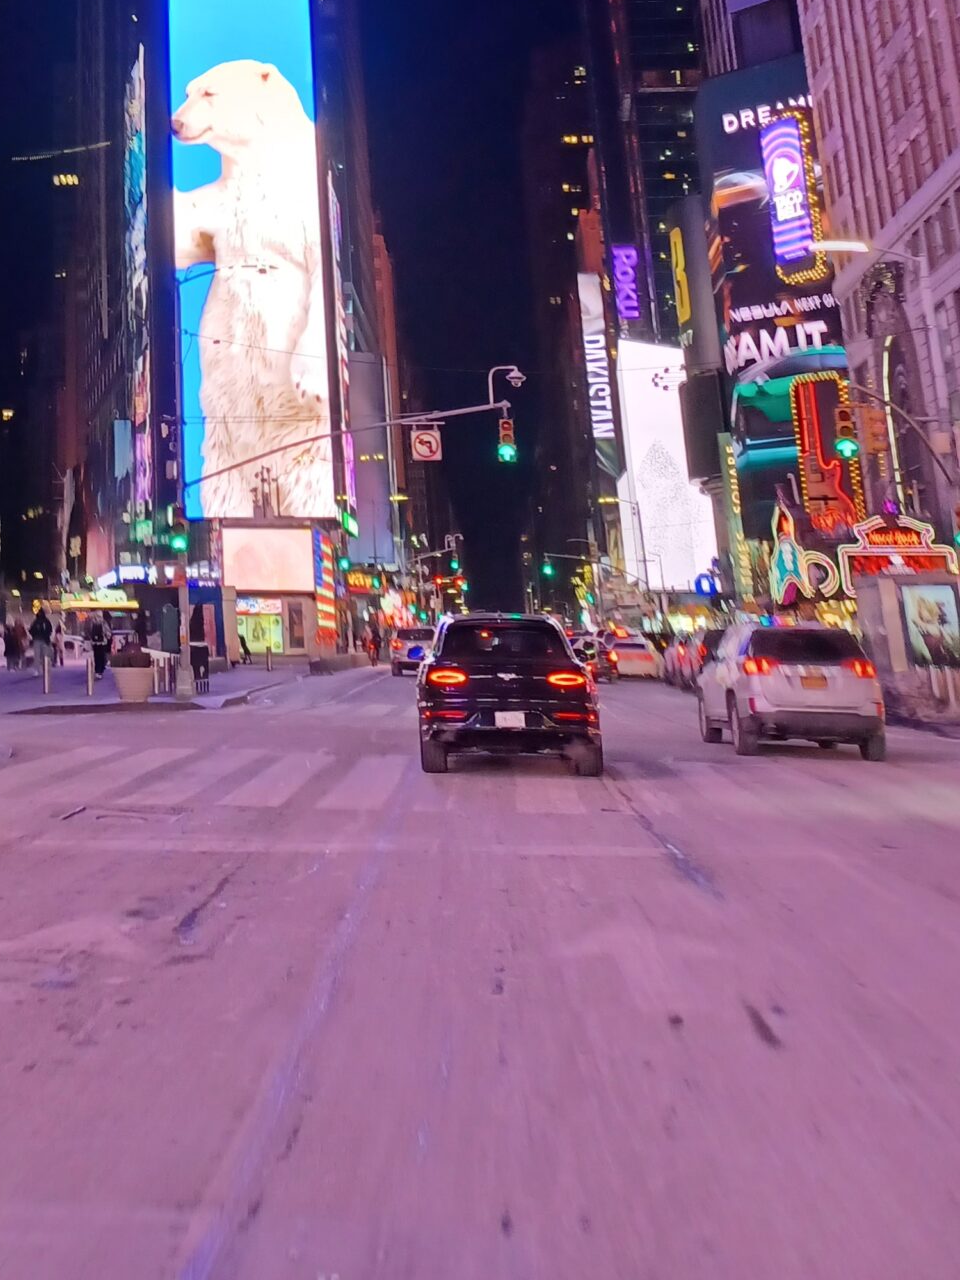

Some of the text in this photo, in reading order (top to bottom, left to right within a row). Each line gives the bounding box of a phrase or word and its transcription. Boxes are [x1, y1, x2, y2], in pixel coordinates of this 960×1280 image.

[773, 190, 804, 207] TACO
[729, 300, 794, 323] NEBULA
[795, 319, 828, 353] IT
